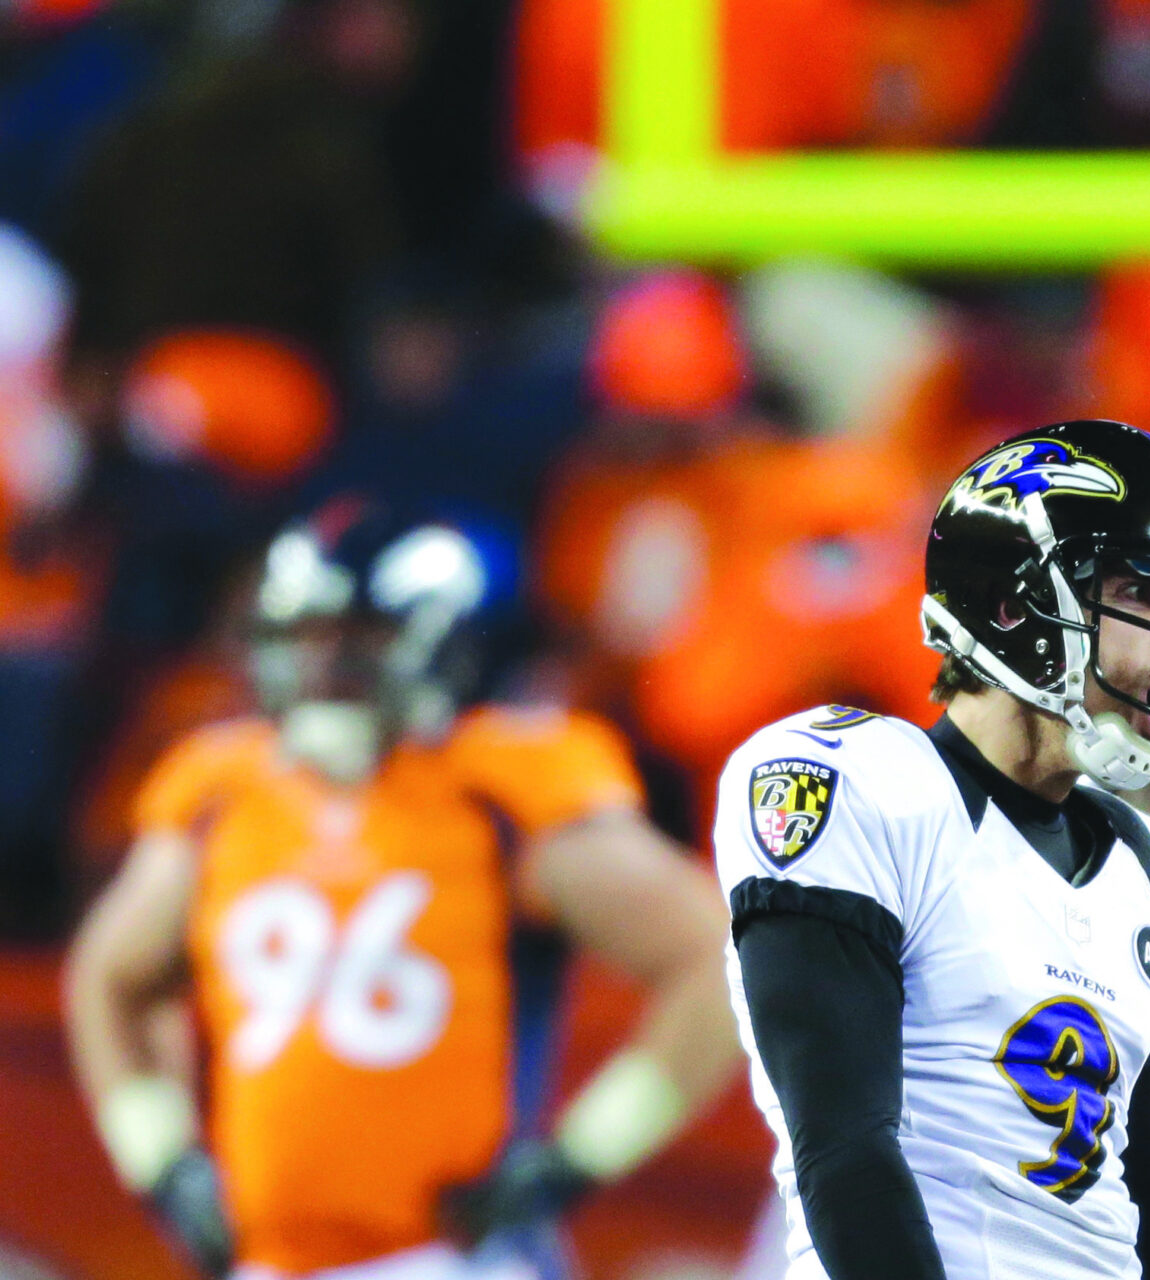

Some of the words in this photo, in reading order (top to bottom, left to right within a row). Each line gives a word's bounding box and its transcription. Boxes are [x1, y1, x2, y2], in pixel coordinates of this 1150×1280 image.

[755, 761, 831, 780] RAVENS
[754, 775, 791, 810] B
[784, 811, 819, 845] R
[217, 866, 454, 1076] 96
[1043, 963, 1116, 1002] RAVENS
[994, 994, 1119, 1206] 9
